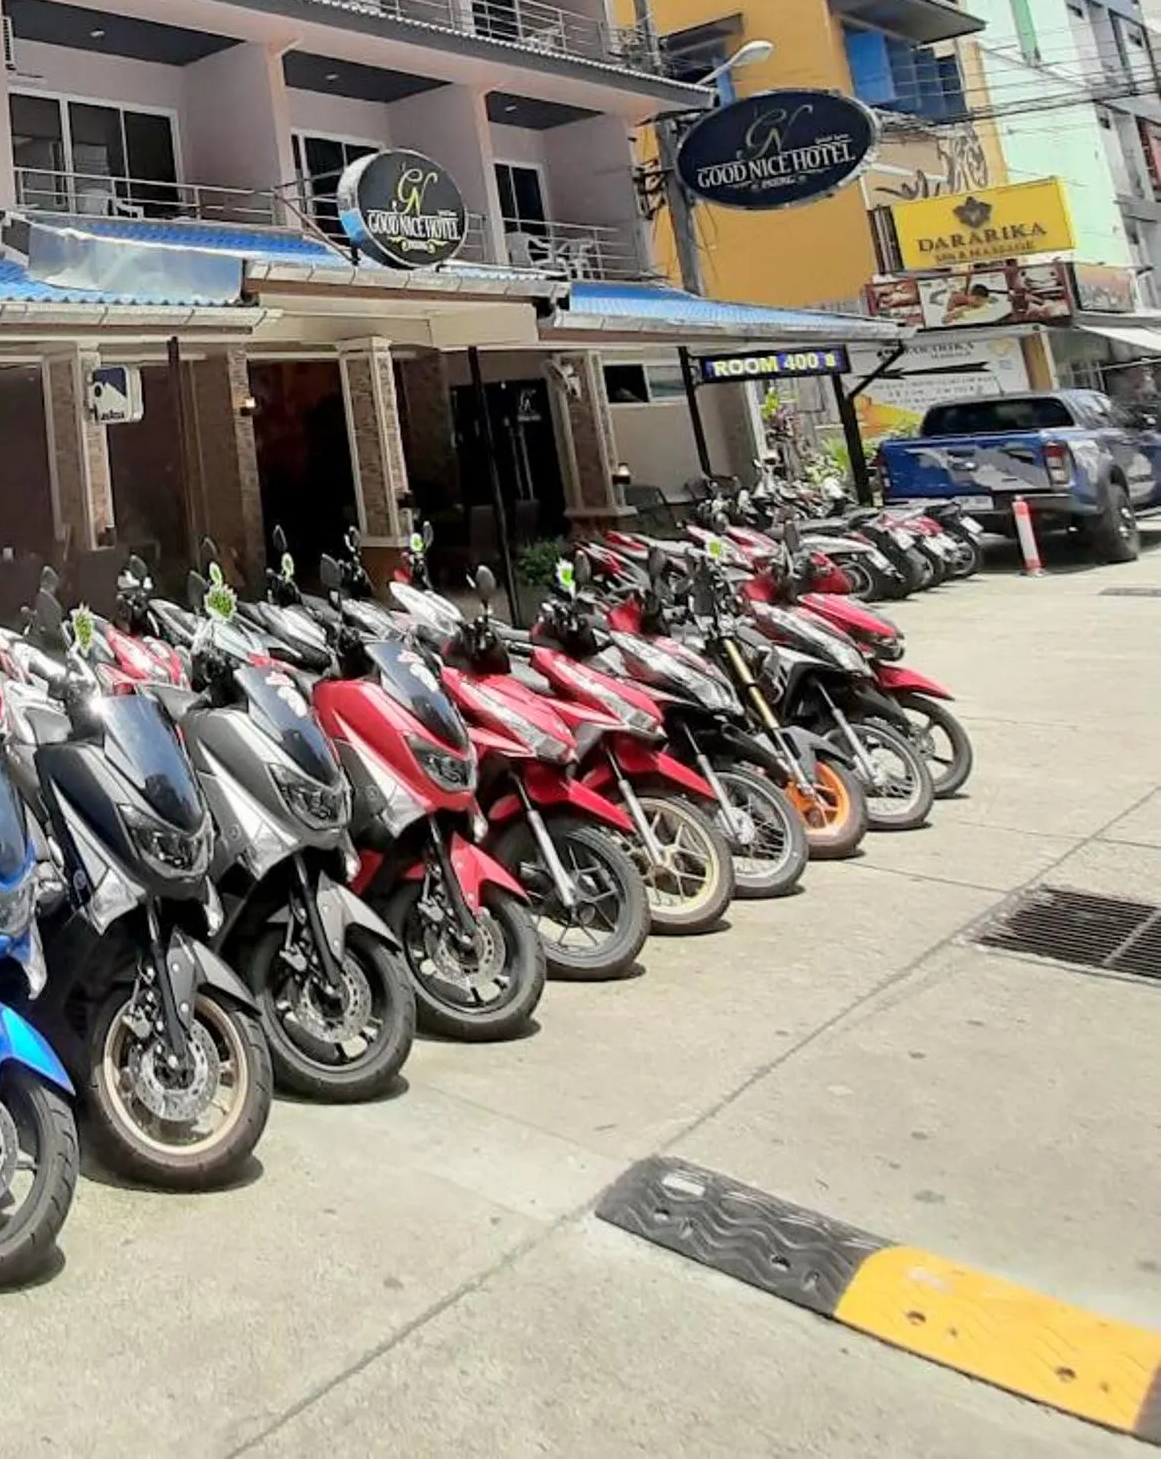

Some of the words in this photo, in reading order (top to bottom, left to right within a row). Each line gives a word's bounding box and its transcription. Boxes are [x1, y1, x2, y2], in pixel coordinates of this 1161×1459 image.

[697, 159, 746, 188] GOOD
[748, 149, 791, 180] NICE
[791, 142, 856, 176] HOTEL
[368, 211, 399, 235] GOOD
[399, 215, 426, 238] NICE
[424, 218, 461, 241] HOTEL
[918, 222, 1047, 253] DARARIKA
[713, 356, 779, 377] ROOM
[783, 353, 819, 370] 400
